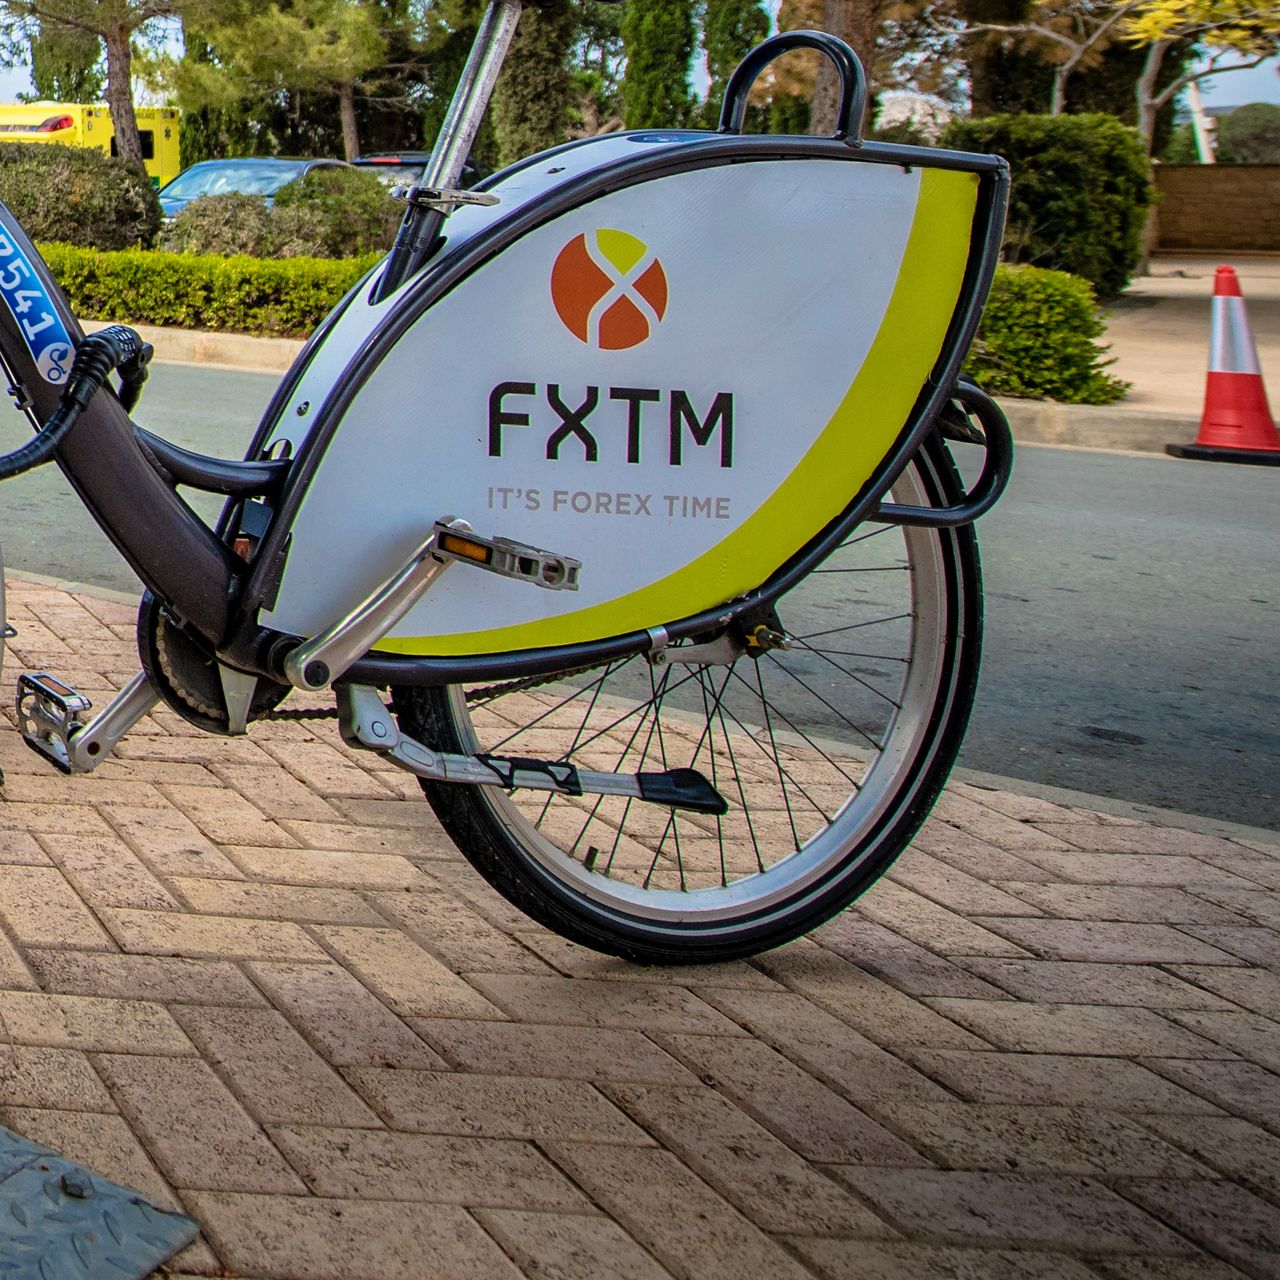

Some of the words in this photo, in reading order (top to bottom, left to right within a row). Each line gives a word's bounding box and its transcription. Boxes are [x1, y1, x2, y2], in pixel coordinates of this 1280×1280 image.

[488, 381, 733, 468] FXTM
[488, 487, 541, 511] IT'S
[552, 489, 653, 517] FOREX
[663, 495, 732, 520] TIME
